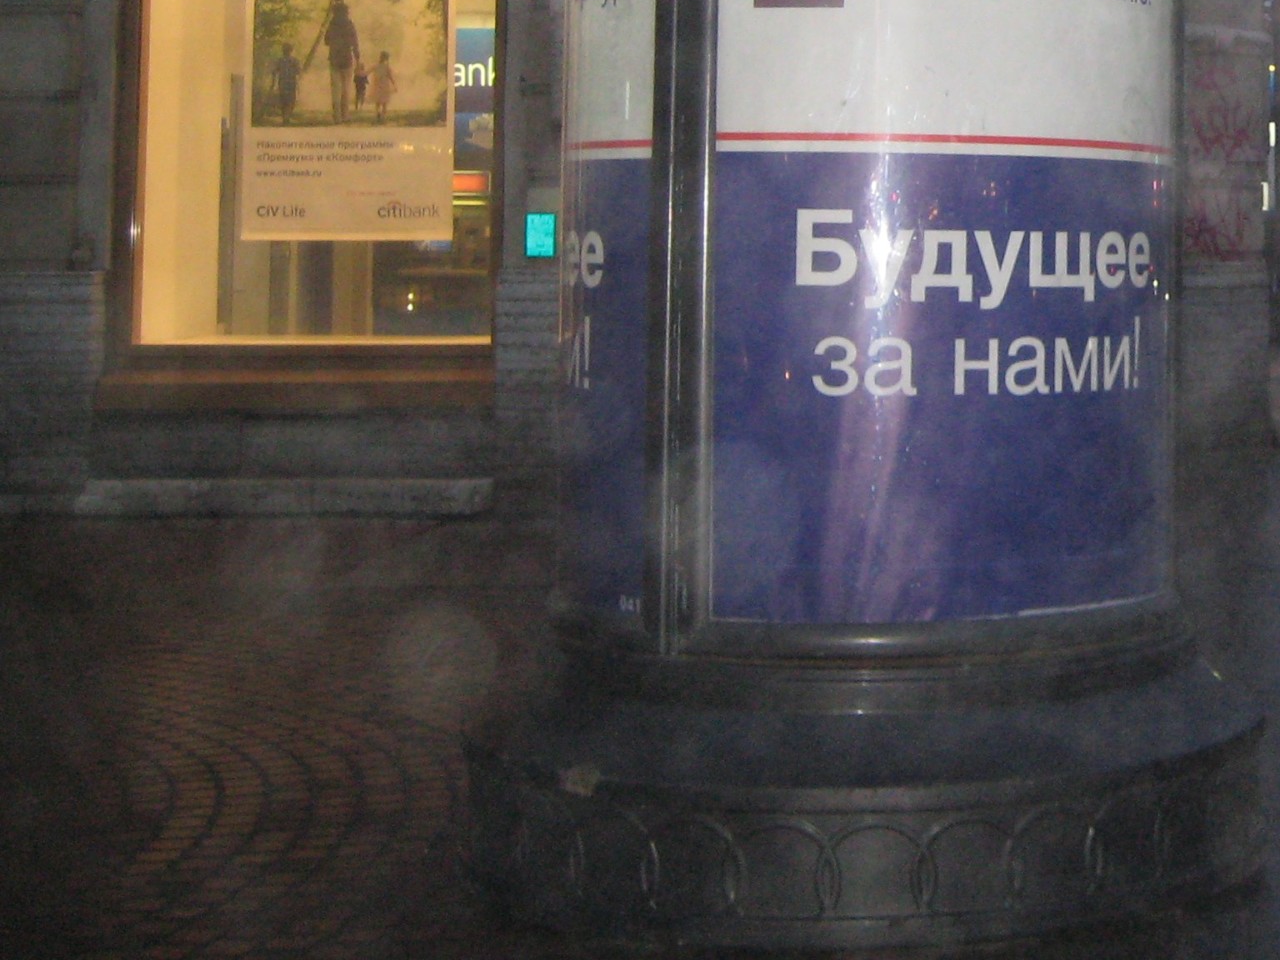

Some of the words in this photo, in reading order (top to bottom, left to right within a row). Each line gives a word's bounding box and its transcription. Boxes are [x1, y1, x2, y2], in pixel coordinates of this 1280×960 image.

[795, 208, 1151, 310] Будущее
[812, 336, 917, 397] за
[953, 315, 1142, 396] нами!
